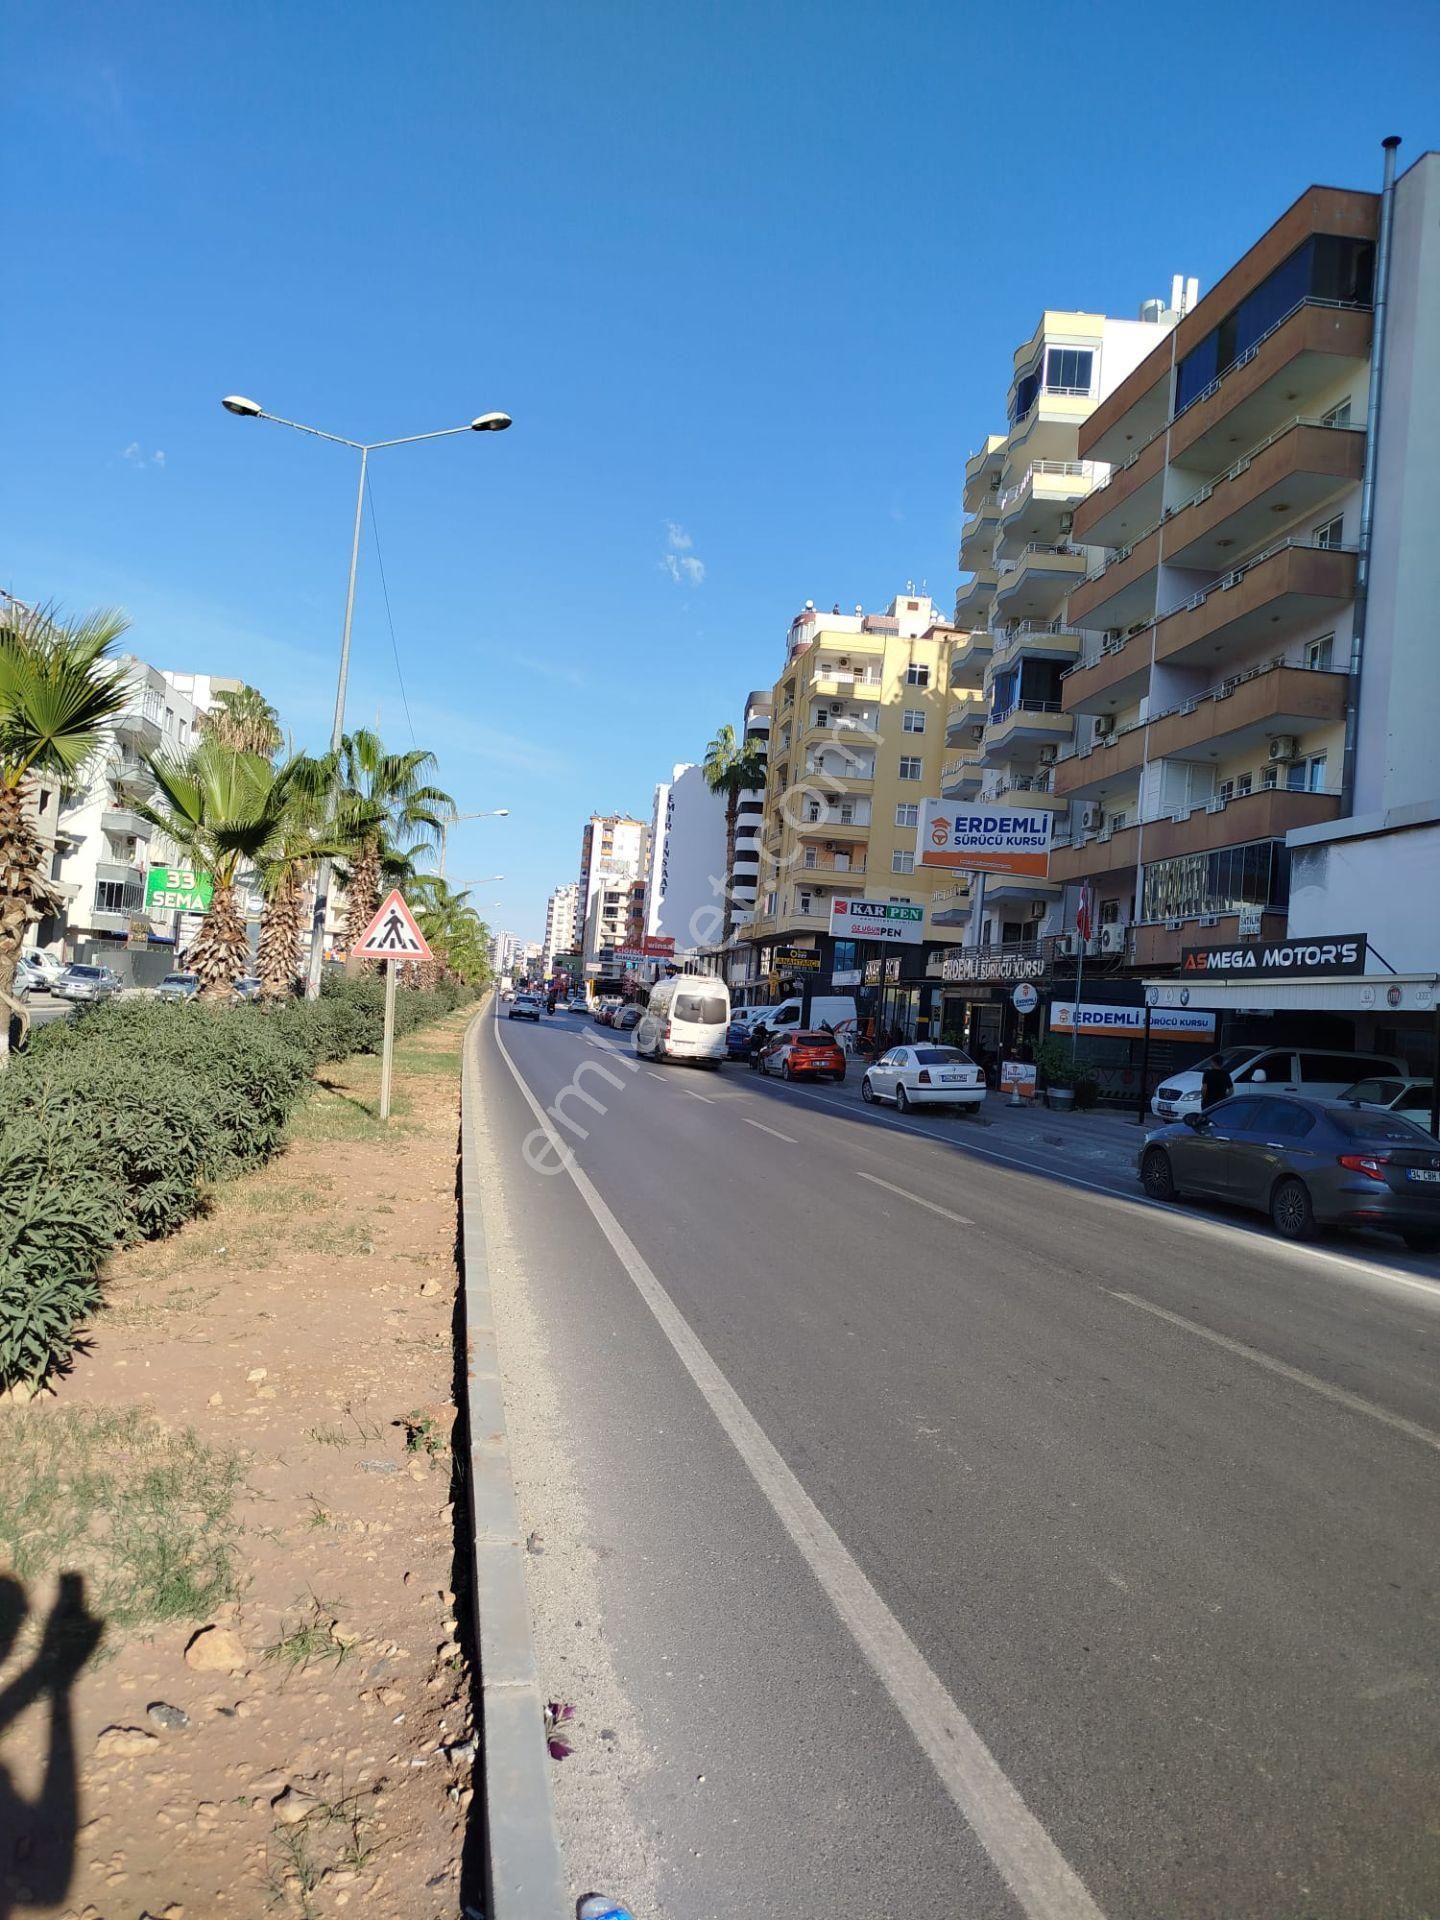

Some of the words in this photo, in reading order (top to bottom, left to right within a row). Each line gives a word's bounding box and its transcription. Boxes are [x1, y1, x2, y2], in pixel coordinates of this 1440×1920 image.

[955, 814, 1048, 833] ERDEMLİ
[954, 834, 1003, 845] SÜRÜCÜ
[1006, 836, 1046, 846] KURSU
[166, 870, 195, 889] 33
[152, 891, 204, 909] SEMA
[852, 904, 885, 916] KAR
[890, 908, 919, 919] PEN
[1262, 944, 1358, 967] MOTOR'S
[942, 957, 979, 980] ERDEMLİ
[1014, 959, 1045, 978] KURSU
[1072, 1011, 1139, 1024] ERDEMLİ
[1180, 1019, 1209, 1027] KURSU
